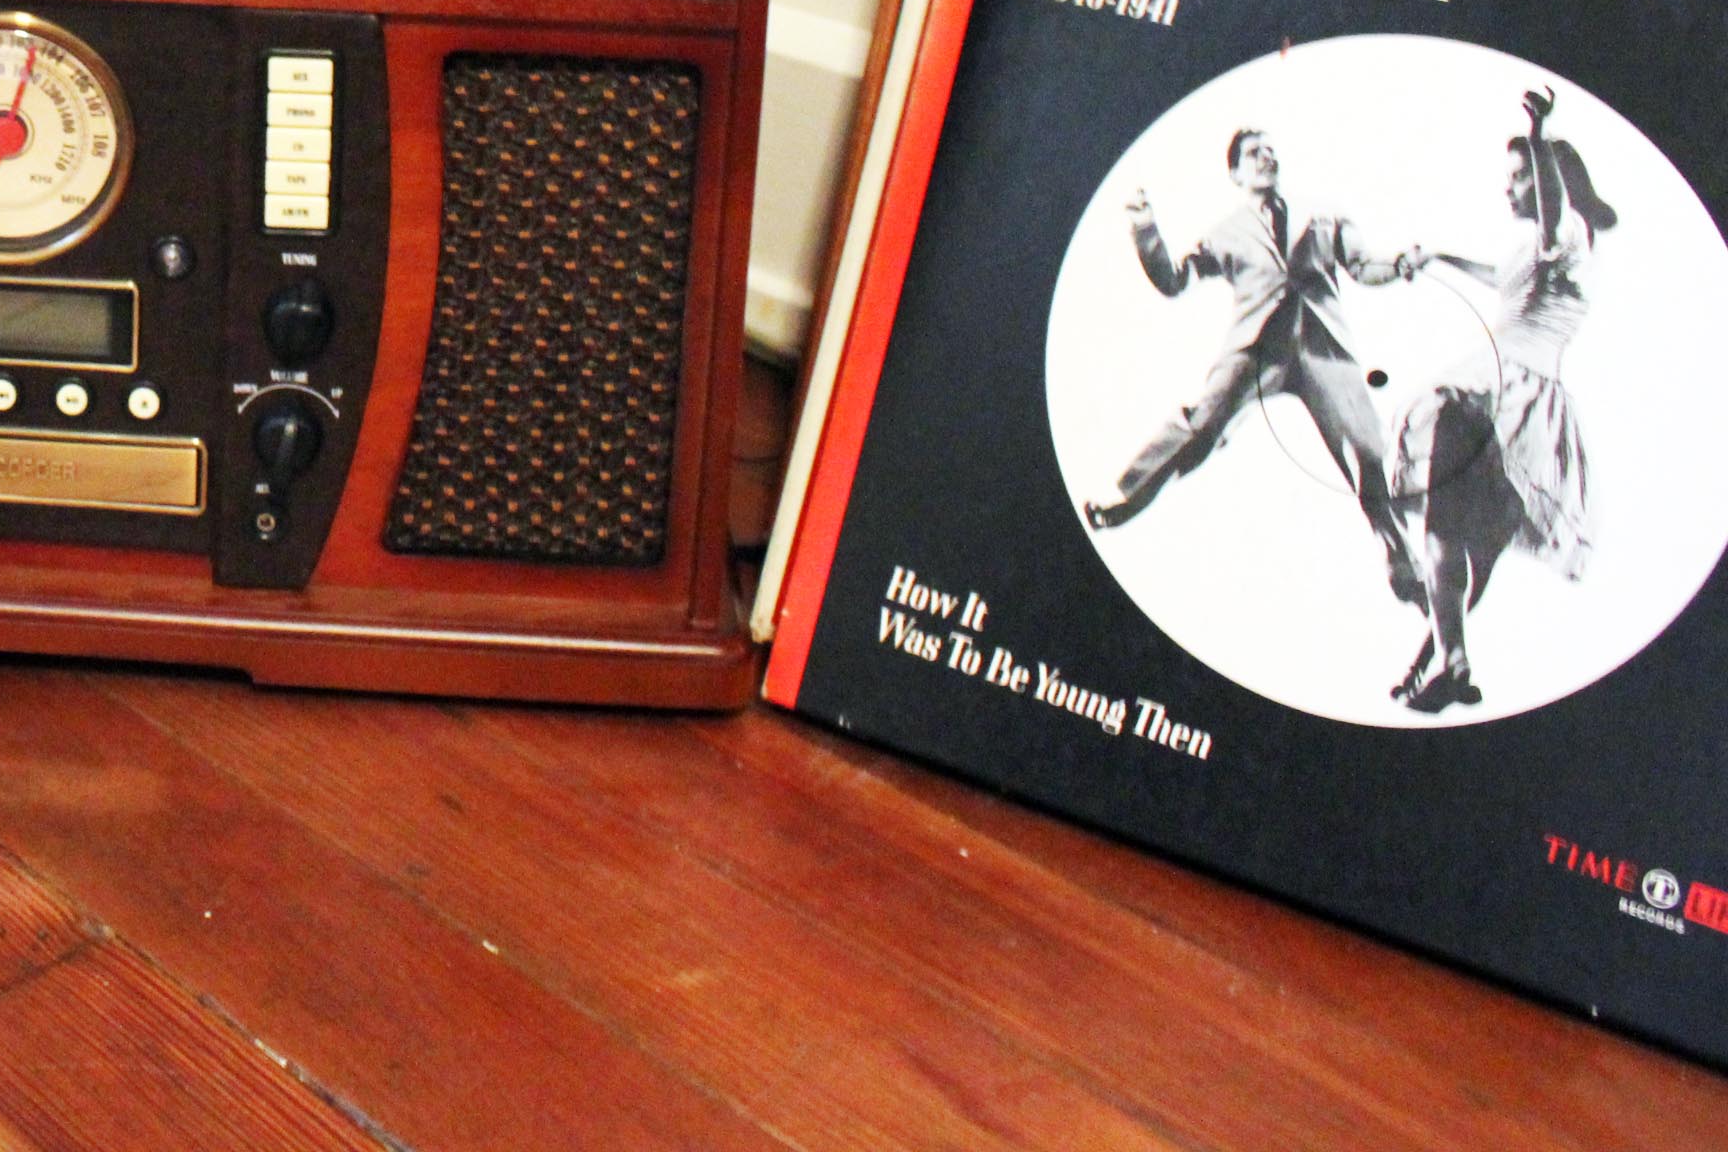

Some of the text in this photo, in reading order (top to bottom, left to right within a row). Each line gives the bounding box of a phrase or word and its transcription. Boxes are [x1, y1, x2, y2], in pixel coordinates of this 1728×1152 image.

[885, 564, 989, 633] How It
[878, 606, 1214, 760] Was To Be Young Then
[1543, 832, 1638, 893] TIME
